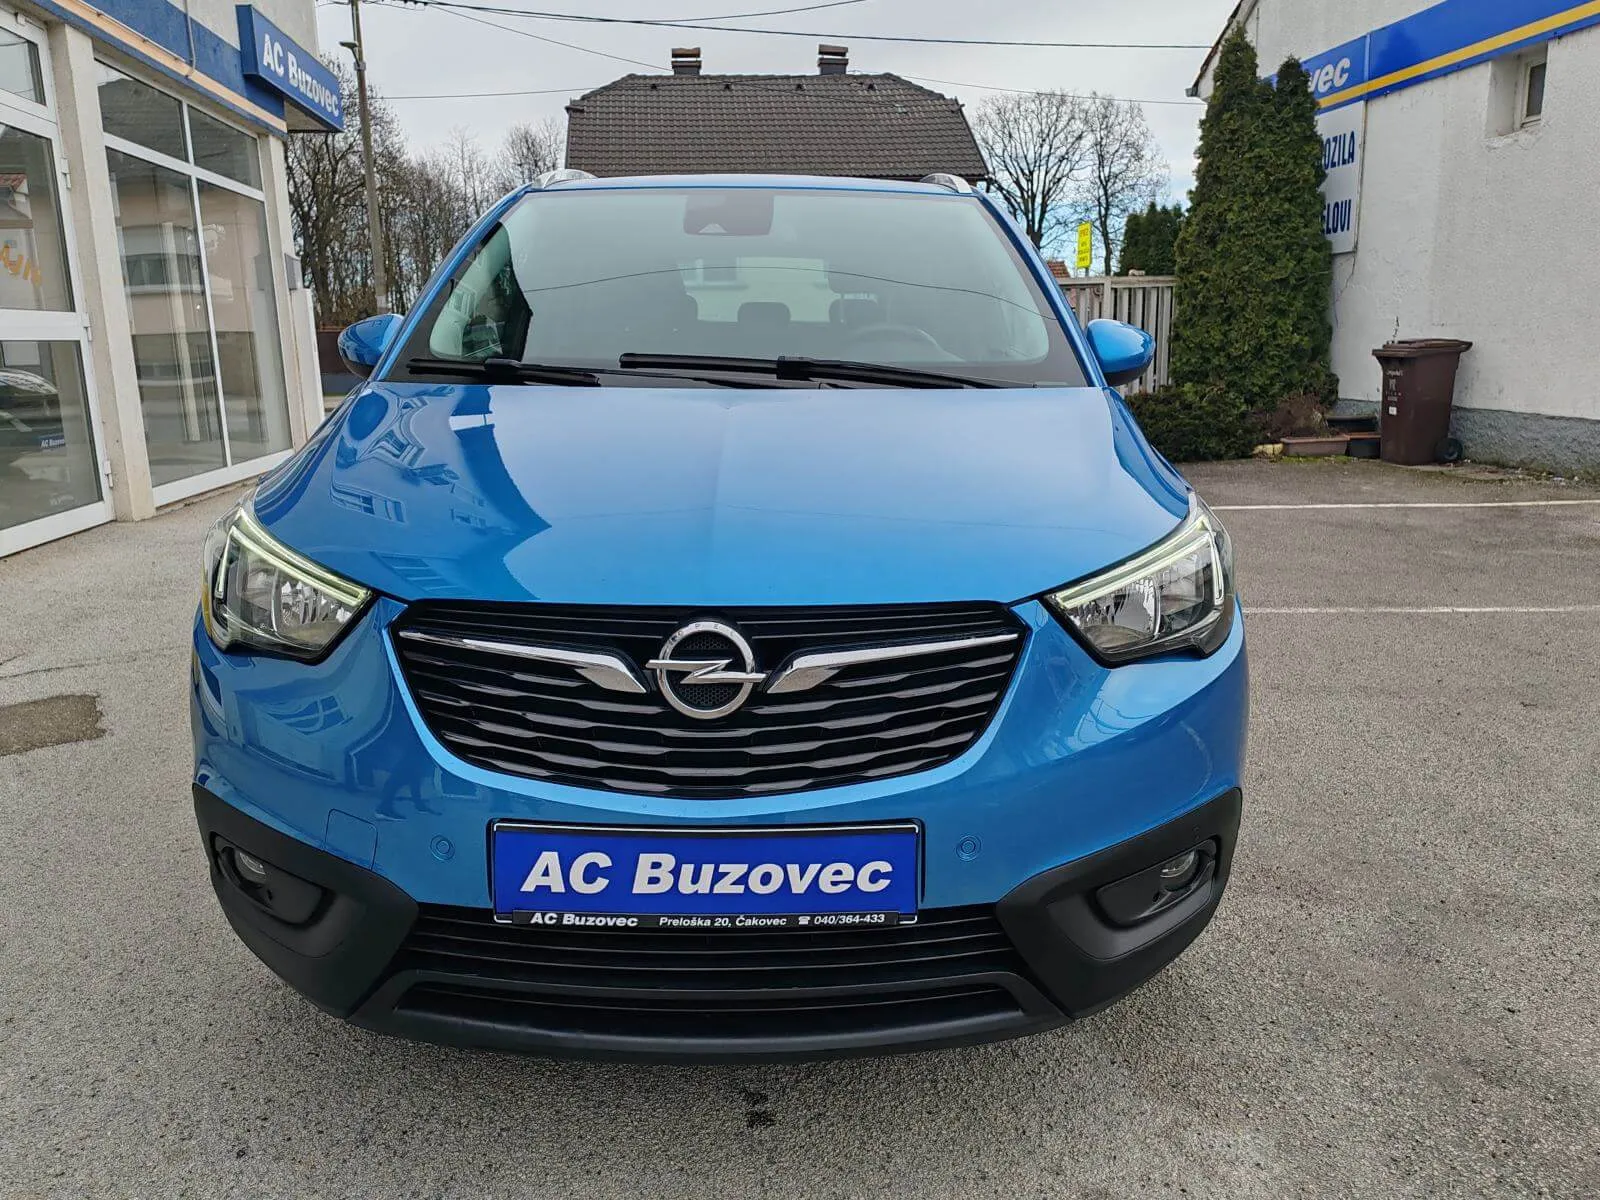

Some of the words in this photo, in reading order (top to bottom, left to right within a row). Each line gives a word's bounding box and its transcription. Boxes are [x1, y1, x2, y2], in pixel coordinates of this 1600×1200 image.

[263, 33, 285, 77] AC
[287, 51, 339, 117] Buzovec
[1307, 57, 1350, 92] vec
[1324, 130, 1355, 170] OZILA
[520, 851, 613, 895] AC
[631, 852, 894, 895] Buzovec
[530, 912, 558, 925] AC
[562, 913, 638, 927] Buzovec
[659, 916, 711, 927] Preloška
[714, 917, 732, 928] 20,
[735, 914, 787, 927] Čakovec
[814, 913, 886, 925] 040/364-433
